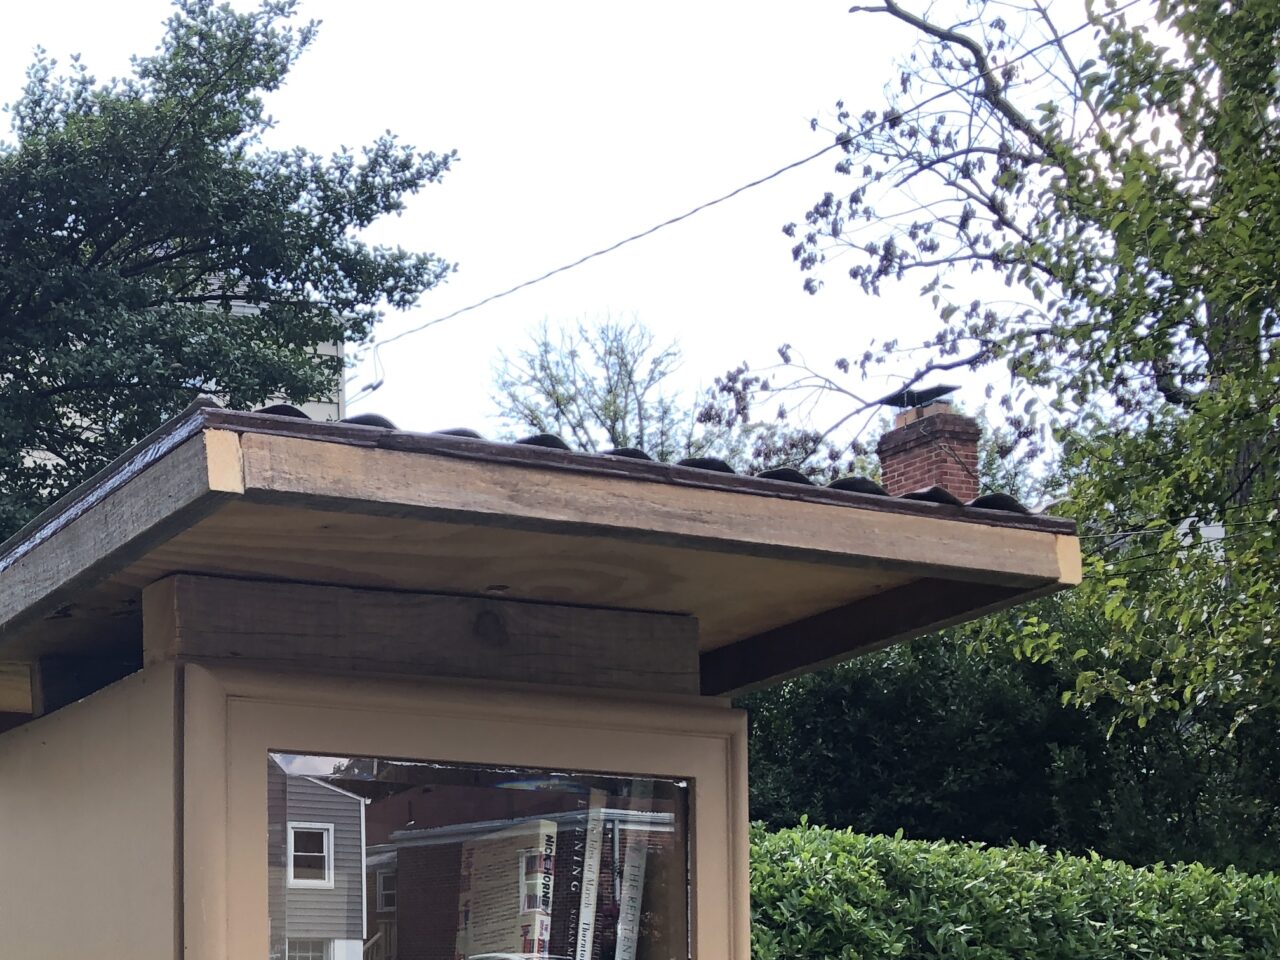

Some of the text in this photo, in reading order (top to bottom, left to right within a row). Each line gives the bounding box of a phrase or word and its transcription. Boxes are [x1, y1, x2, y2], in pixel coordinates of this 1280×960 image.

[543, 834, 554, 862] NICK
[571, 800, 587, 892] EVENING
[587, 863, 595, 874] of
[630, 865, 640, 891] THE
[540, 867, 553, 912] HORNB
[584, 881, 595, 908] March
[626, 896, 637, 921] RED
[568, 909, 577, 943] SUSAN
